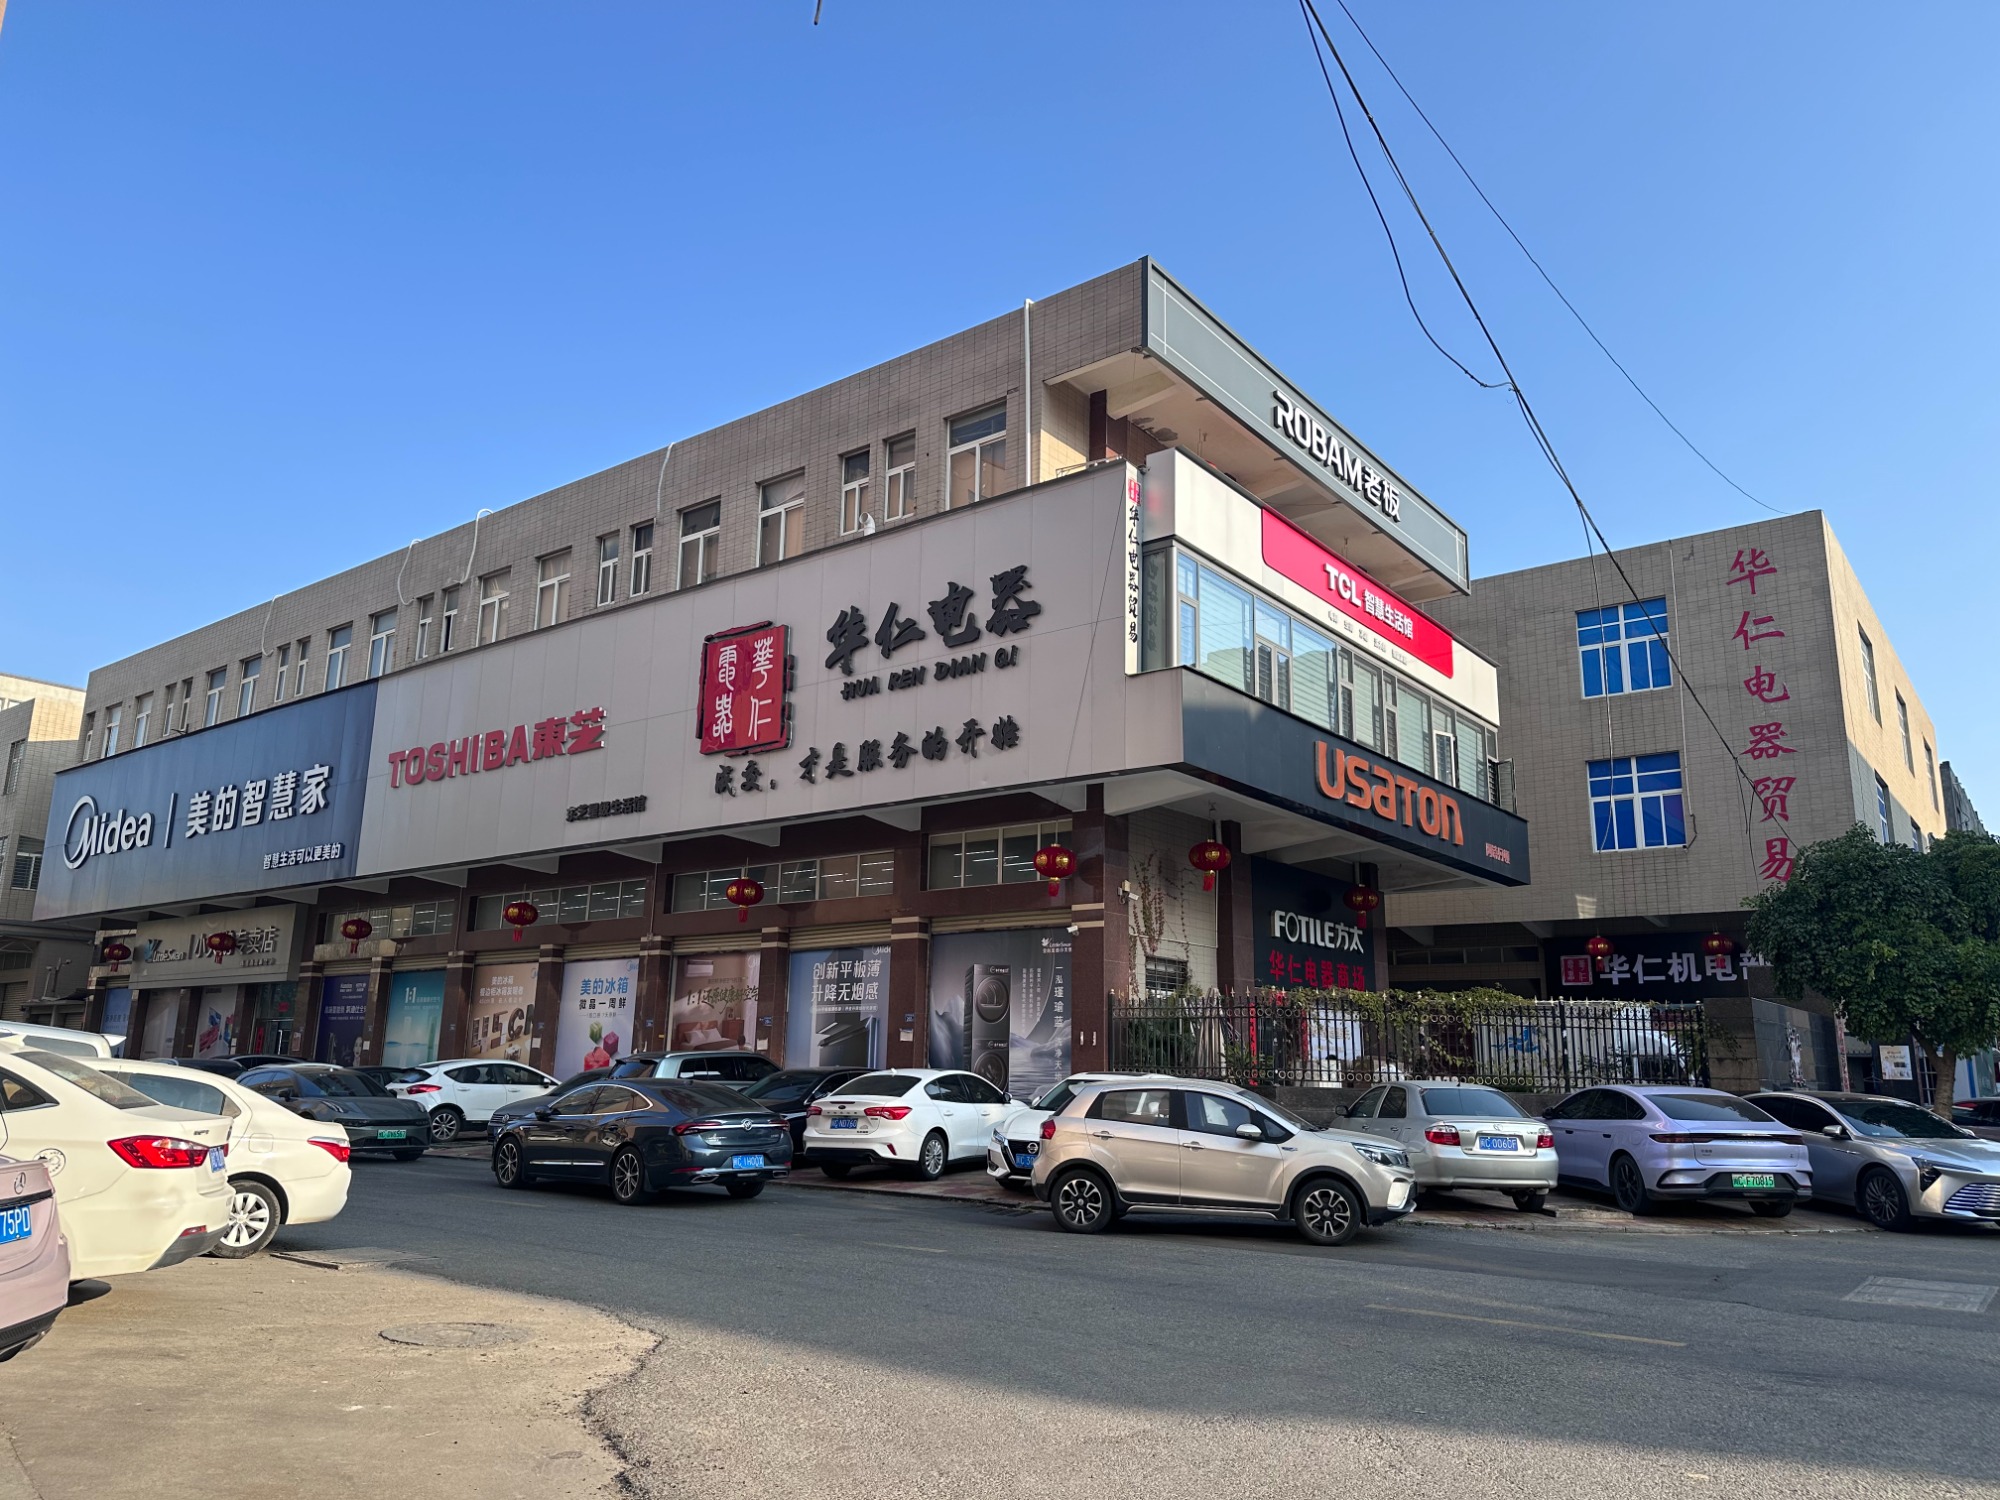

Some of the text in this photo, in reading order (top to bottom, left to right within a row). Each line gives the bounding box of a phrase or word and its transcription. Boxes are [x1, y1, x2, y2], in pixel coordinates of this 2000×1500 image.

[825, 565, 1042, 675] 华仁电器
[1324, 563, 1413, 640] TCL 智慧生活馆
[840, 645, 1019, 700] HUA REN DIAN QI
[1726, 547, 1799, 882] 华仁电器贸易
[63, 763, 332, 870] Midea 美的智慧家
[263, 842, 343, 870] 智慧生活可以更美的
[580, 976, 629, 996] 美的冰箱
[813, 959, 881, 980] 创新平板薄
[1269, 949, 1365, 992] 华仁电器商场
[578, 996, 626, 1010] 微晶一周鲜
[811, 982, 879, 1002] 升降无烟感
